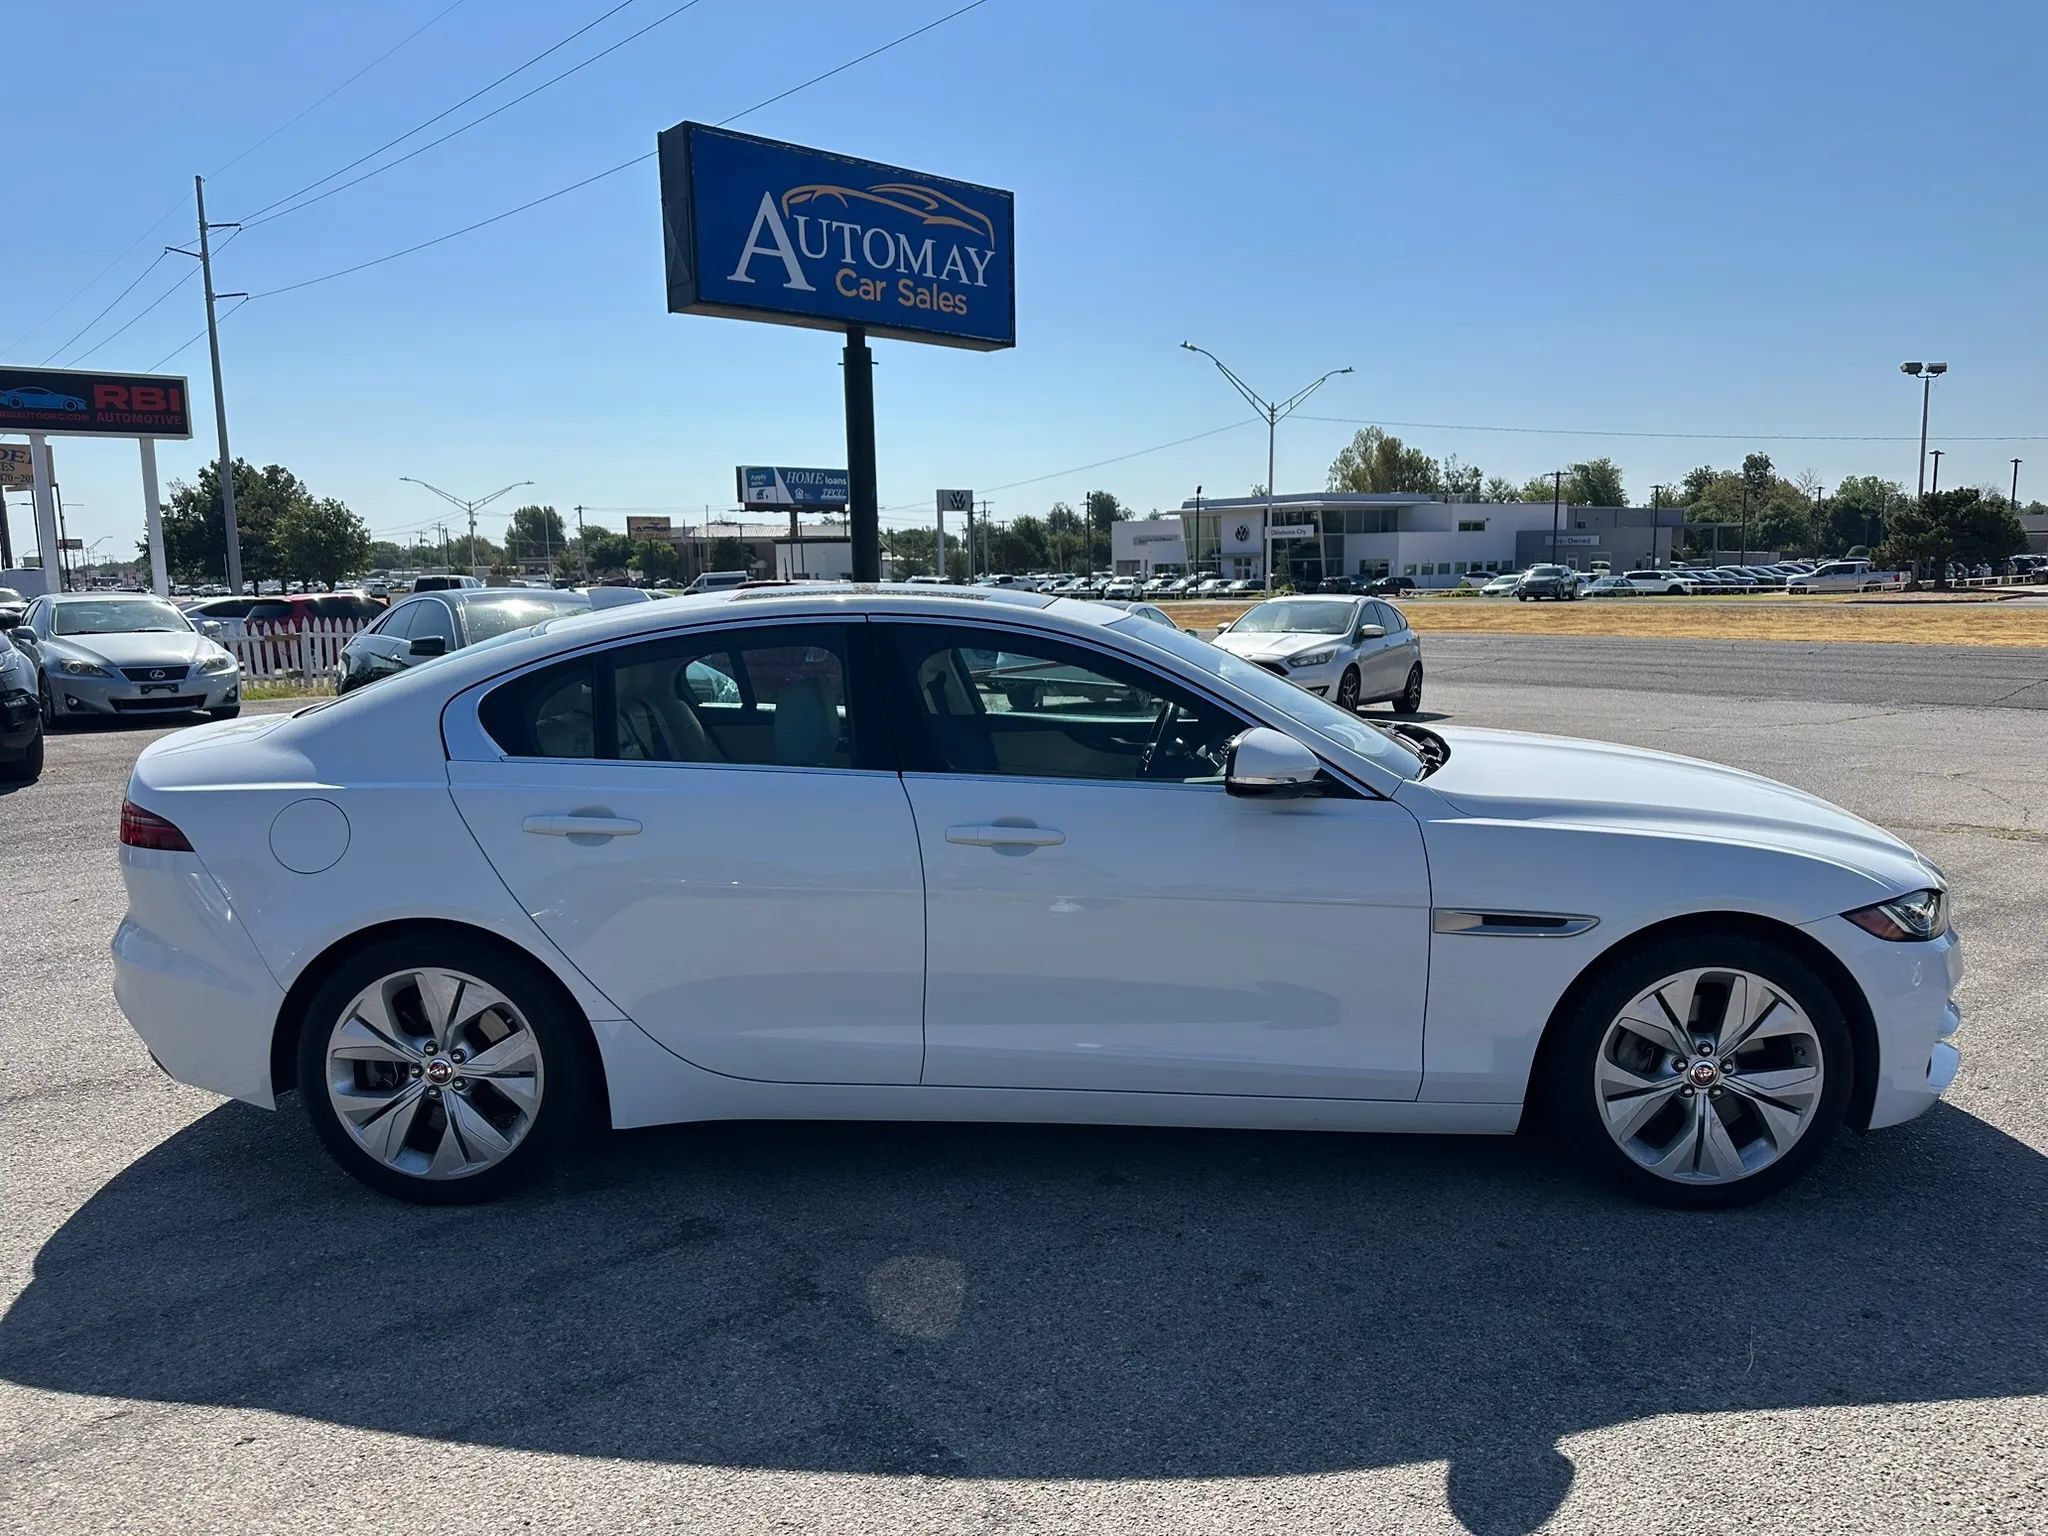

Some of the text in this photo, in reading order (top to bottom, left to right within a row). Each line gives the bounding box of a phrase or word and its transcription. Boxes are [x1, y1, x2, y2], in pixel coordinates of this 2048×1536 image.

[835, 268, 968, 316] Car Sales
[94, 384, 180, 411] RBI
[96, 412, 182, 424] AUTOMOTIVE
[786, 471, 847, 486] HOME loans
